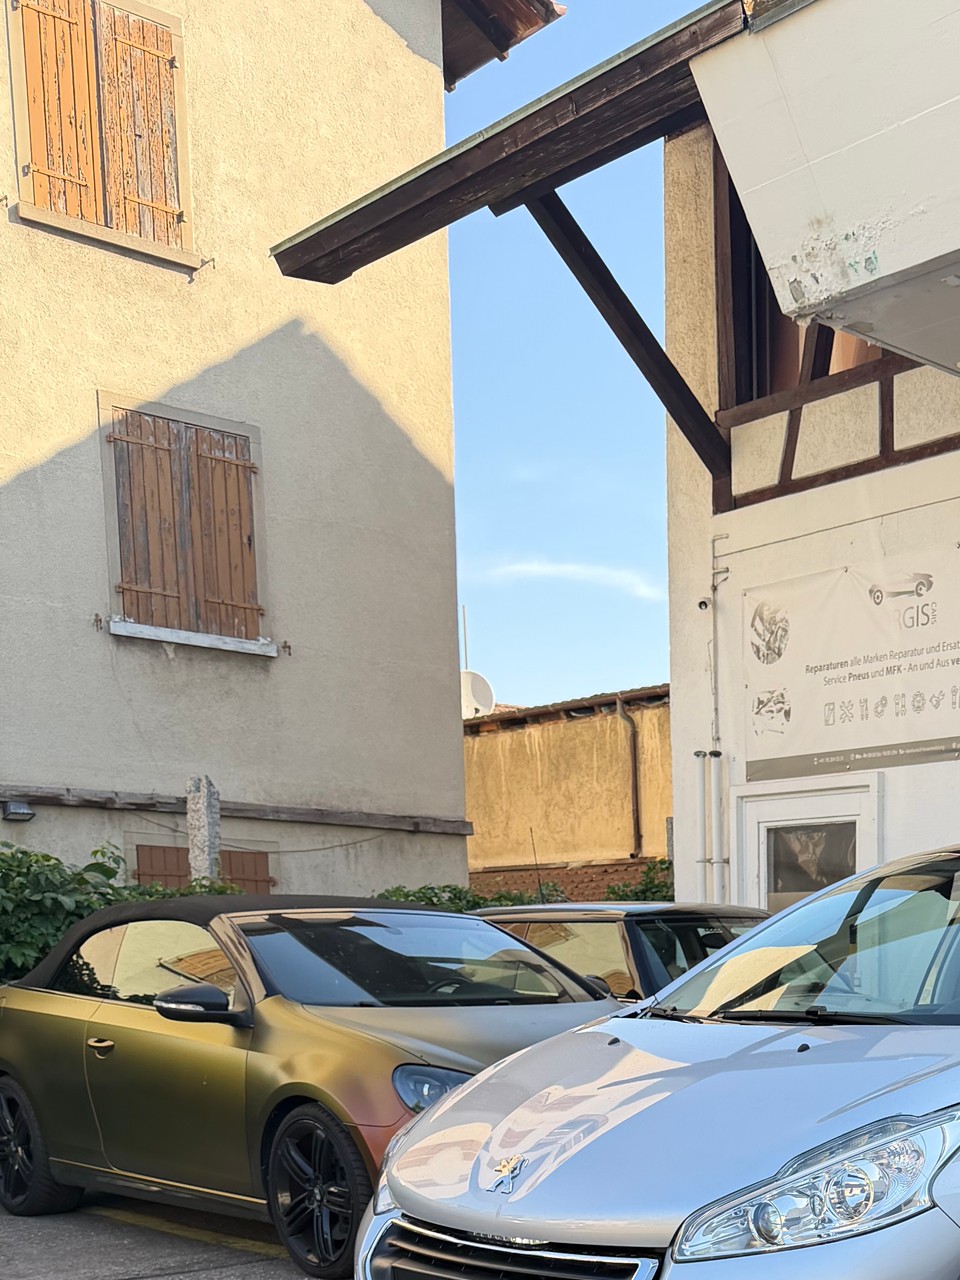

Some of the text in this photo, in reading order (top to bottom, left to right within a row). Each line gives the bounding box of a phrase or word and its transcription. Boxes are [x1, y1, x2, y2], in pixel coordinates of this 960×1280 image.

[805, 660, 849, 675] Reparaturen
[850, 656, 862, 667] alle
[863, 653, 888, 664] Marken
[889, 647, 924, 662] Reparatur
[925, 642, 941, 654] und
[823, 675, 847, 686] Service
[848, 672, 870, 682] Pneus
[870, 667, 885, 678] und
[885, 664, 902, 676] MFK
[907, 663, 918, 672] An
[919, 659, 934, 671] und
[935, 658, 950, 668] Aus
